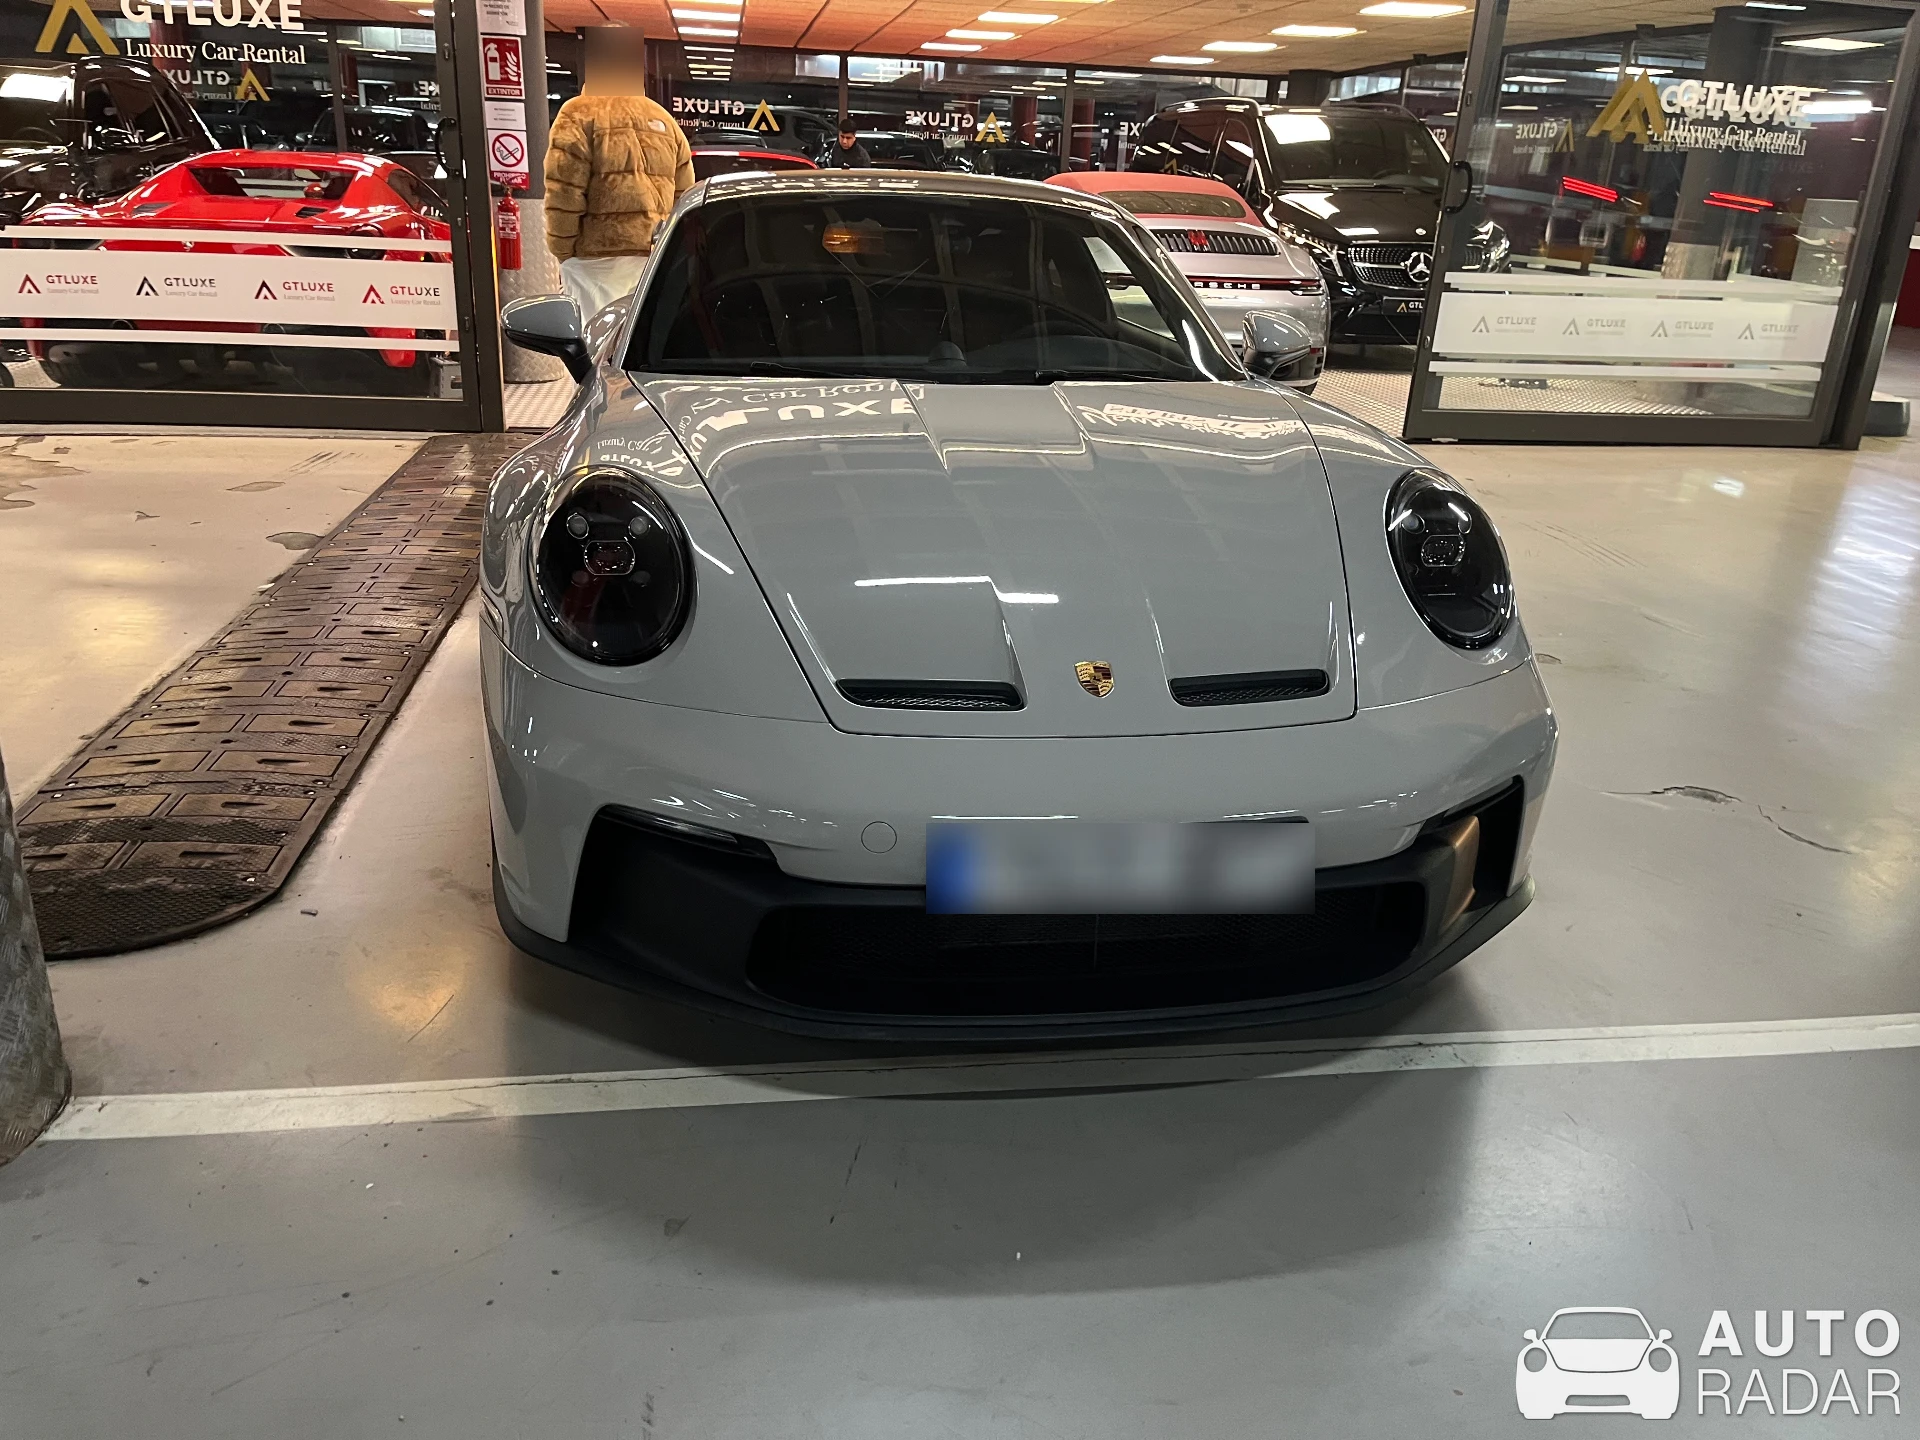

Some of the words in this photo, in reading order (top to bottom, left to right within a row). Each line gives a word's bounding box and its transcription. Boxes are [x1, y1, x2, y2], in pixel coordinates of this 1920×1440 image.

[125, 39, 196, 63] Luxury
[202, 42, 238, 60] Car
[242, 43, 307, 65] Rental
[488, 87, 521, 96] EXTINTOR
[46, 275, 98, 285] GTLUXE
[164, 277, 216, 288] GTLUXE
[282, 281, 334, 292] GTLUXE
[1194, 281, 1260, 290] RSCHE
[390, 285, 440, 297] GTLUXE
[1497, 316, 1537, 326] GTLUXE
